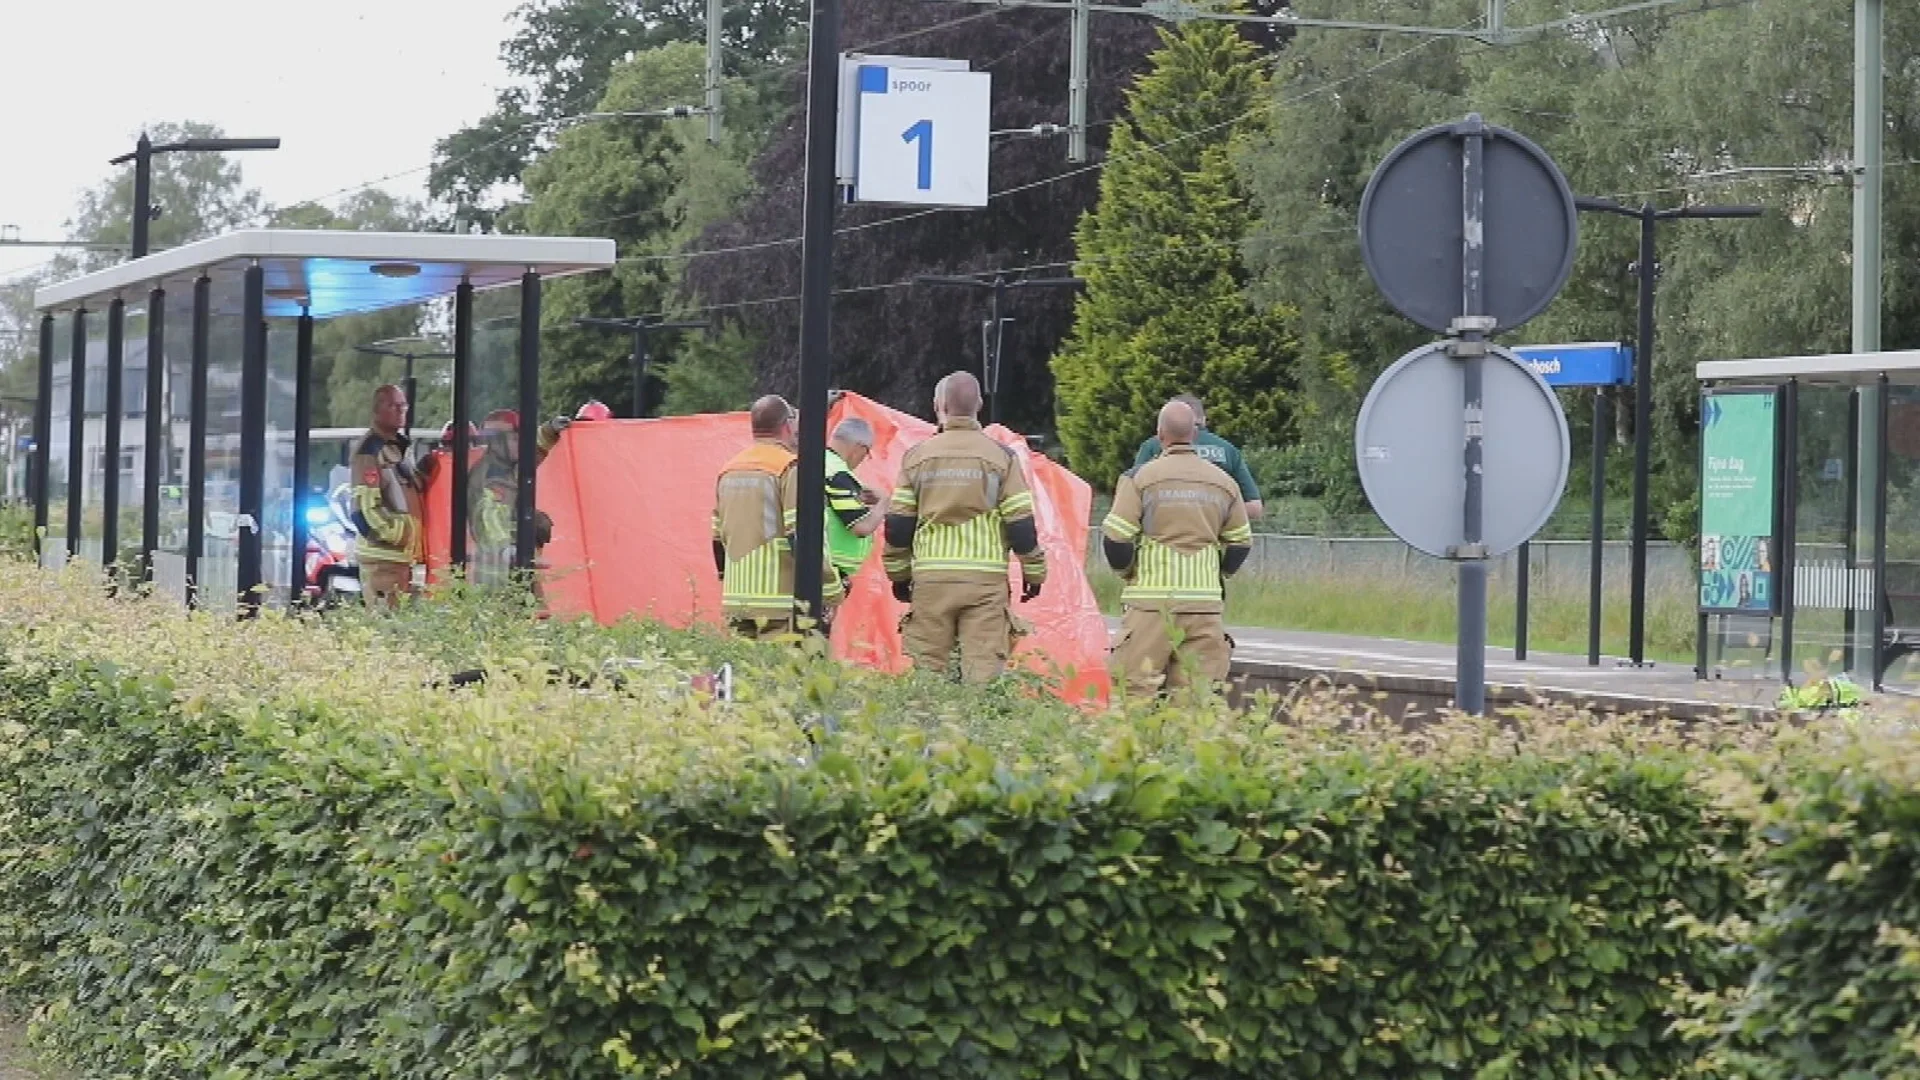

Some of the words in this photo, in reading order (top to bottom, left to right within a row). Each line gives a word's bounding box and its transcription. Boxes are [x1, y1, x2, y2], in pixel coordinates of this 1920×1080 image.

[892, 80, 931, 93] spoor
[901, 119, 933, 189] 1
[1530, 354, 1561, 374] bosch
